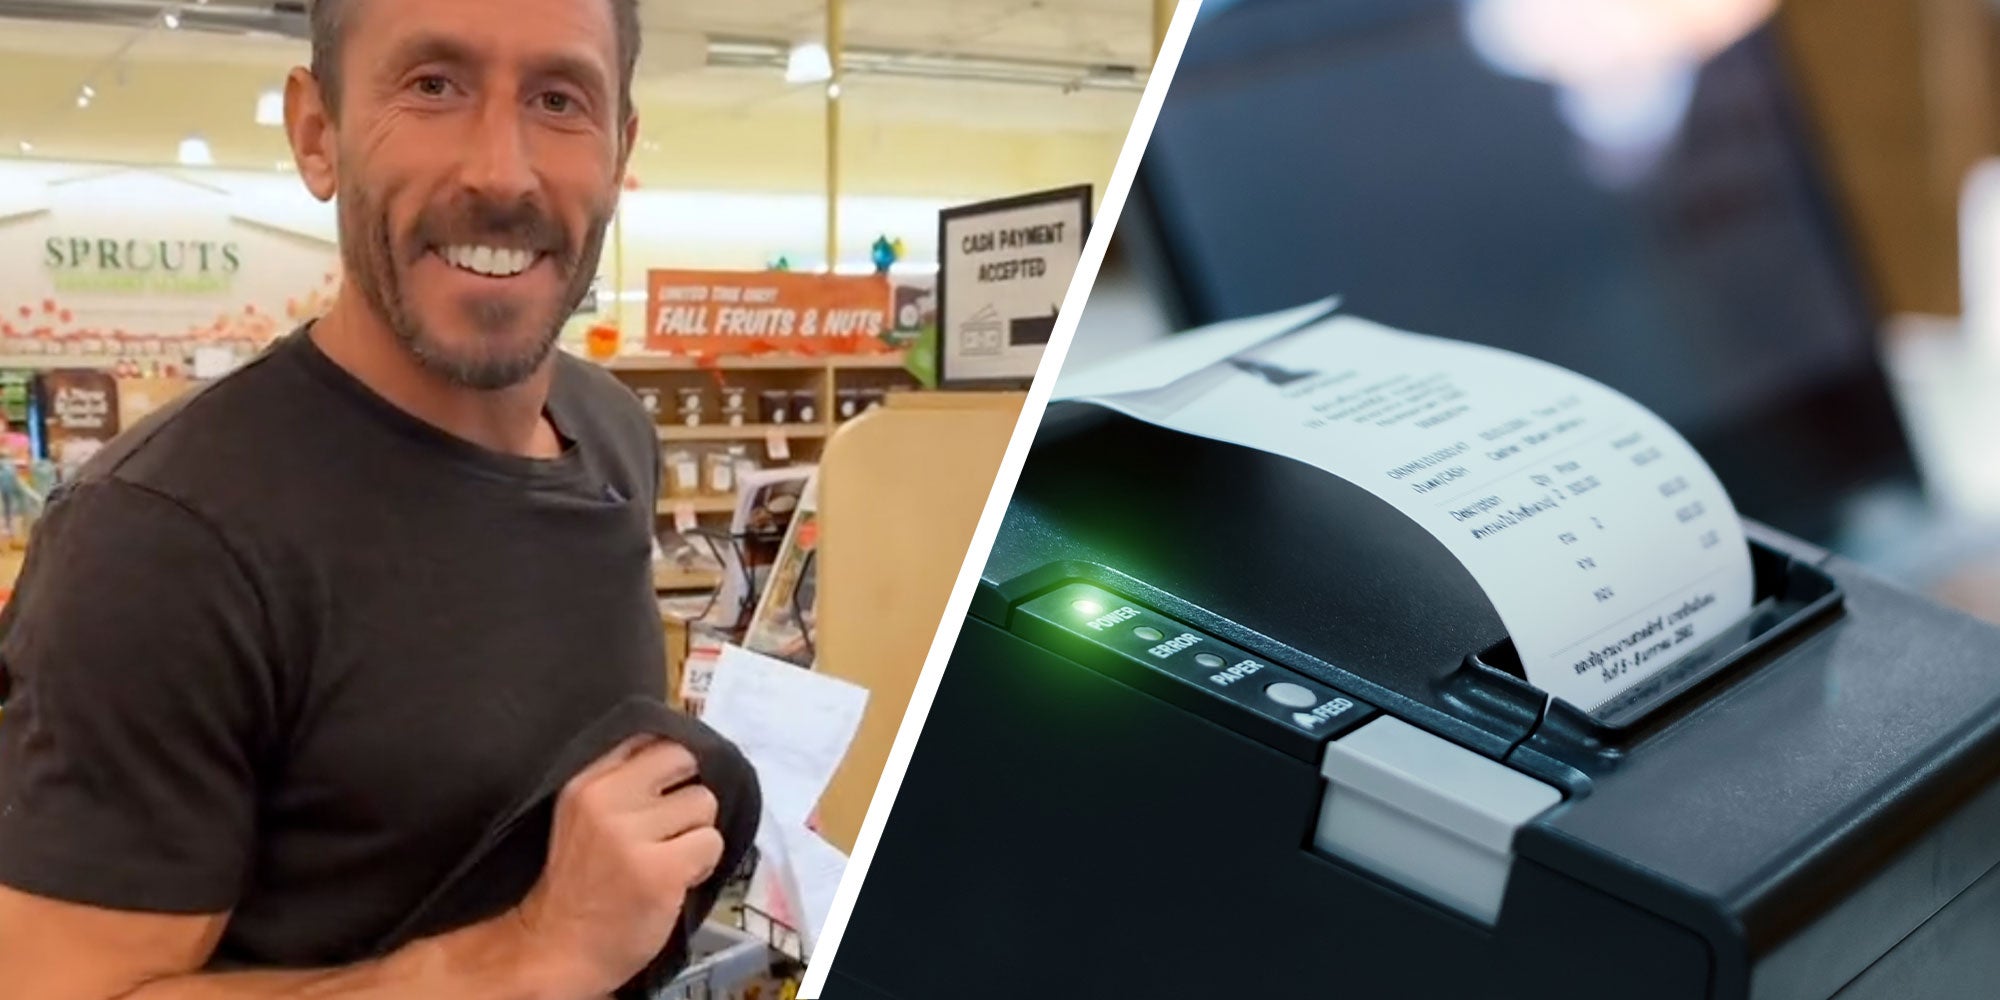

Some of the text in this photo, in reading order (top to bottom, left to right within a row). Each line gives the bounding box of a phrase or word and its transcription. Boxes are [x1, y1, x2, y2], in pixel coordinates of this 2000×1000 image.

[961, 222, 1066, 255] CASH PAYMENT
[44, 236, 241, 273] SPROUTS
[977, 256, 1048, 283] ACCEPTED
[655, 304, 883, 337] FALL FRUITS & NUTS
[1086, 605, 1141, 631] POWER
[1148, 632, 1203, 659] ERROR
[1209, 658, 1265, 687] PAPER
[1311, 697, 1354, 719] FEED
